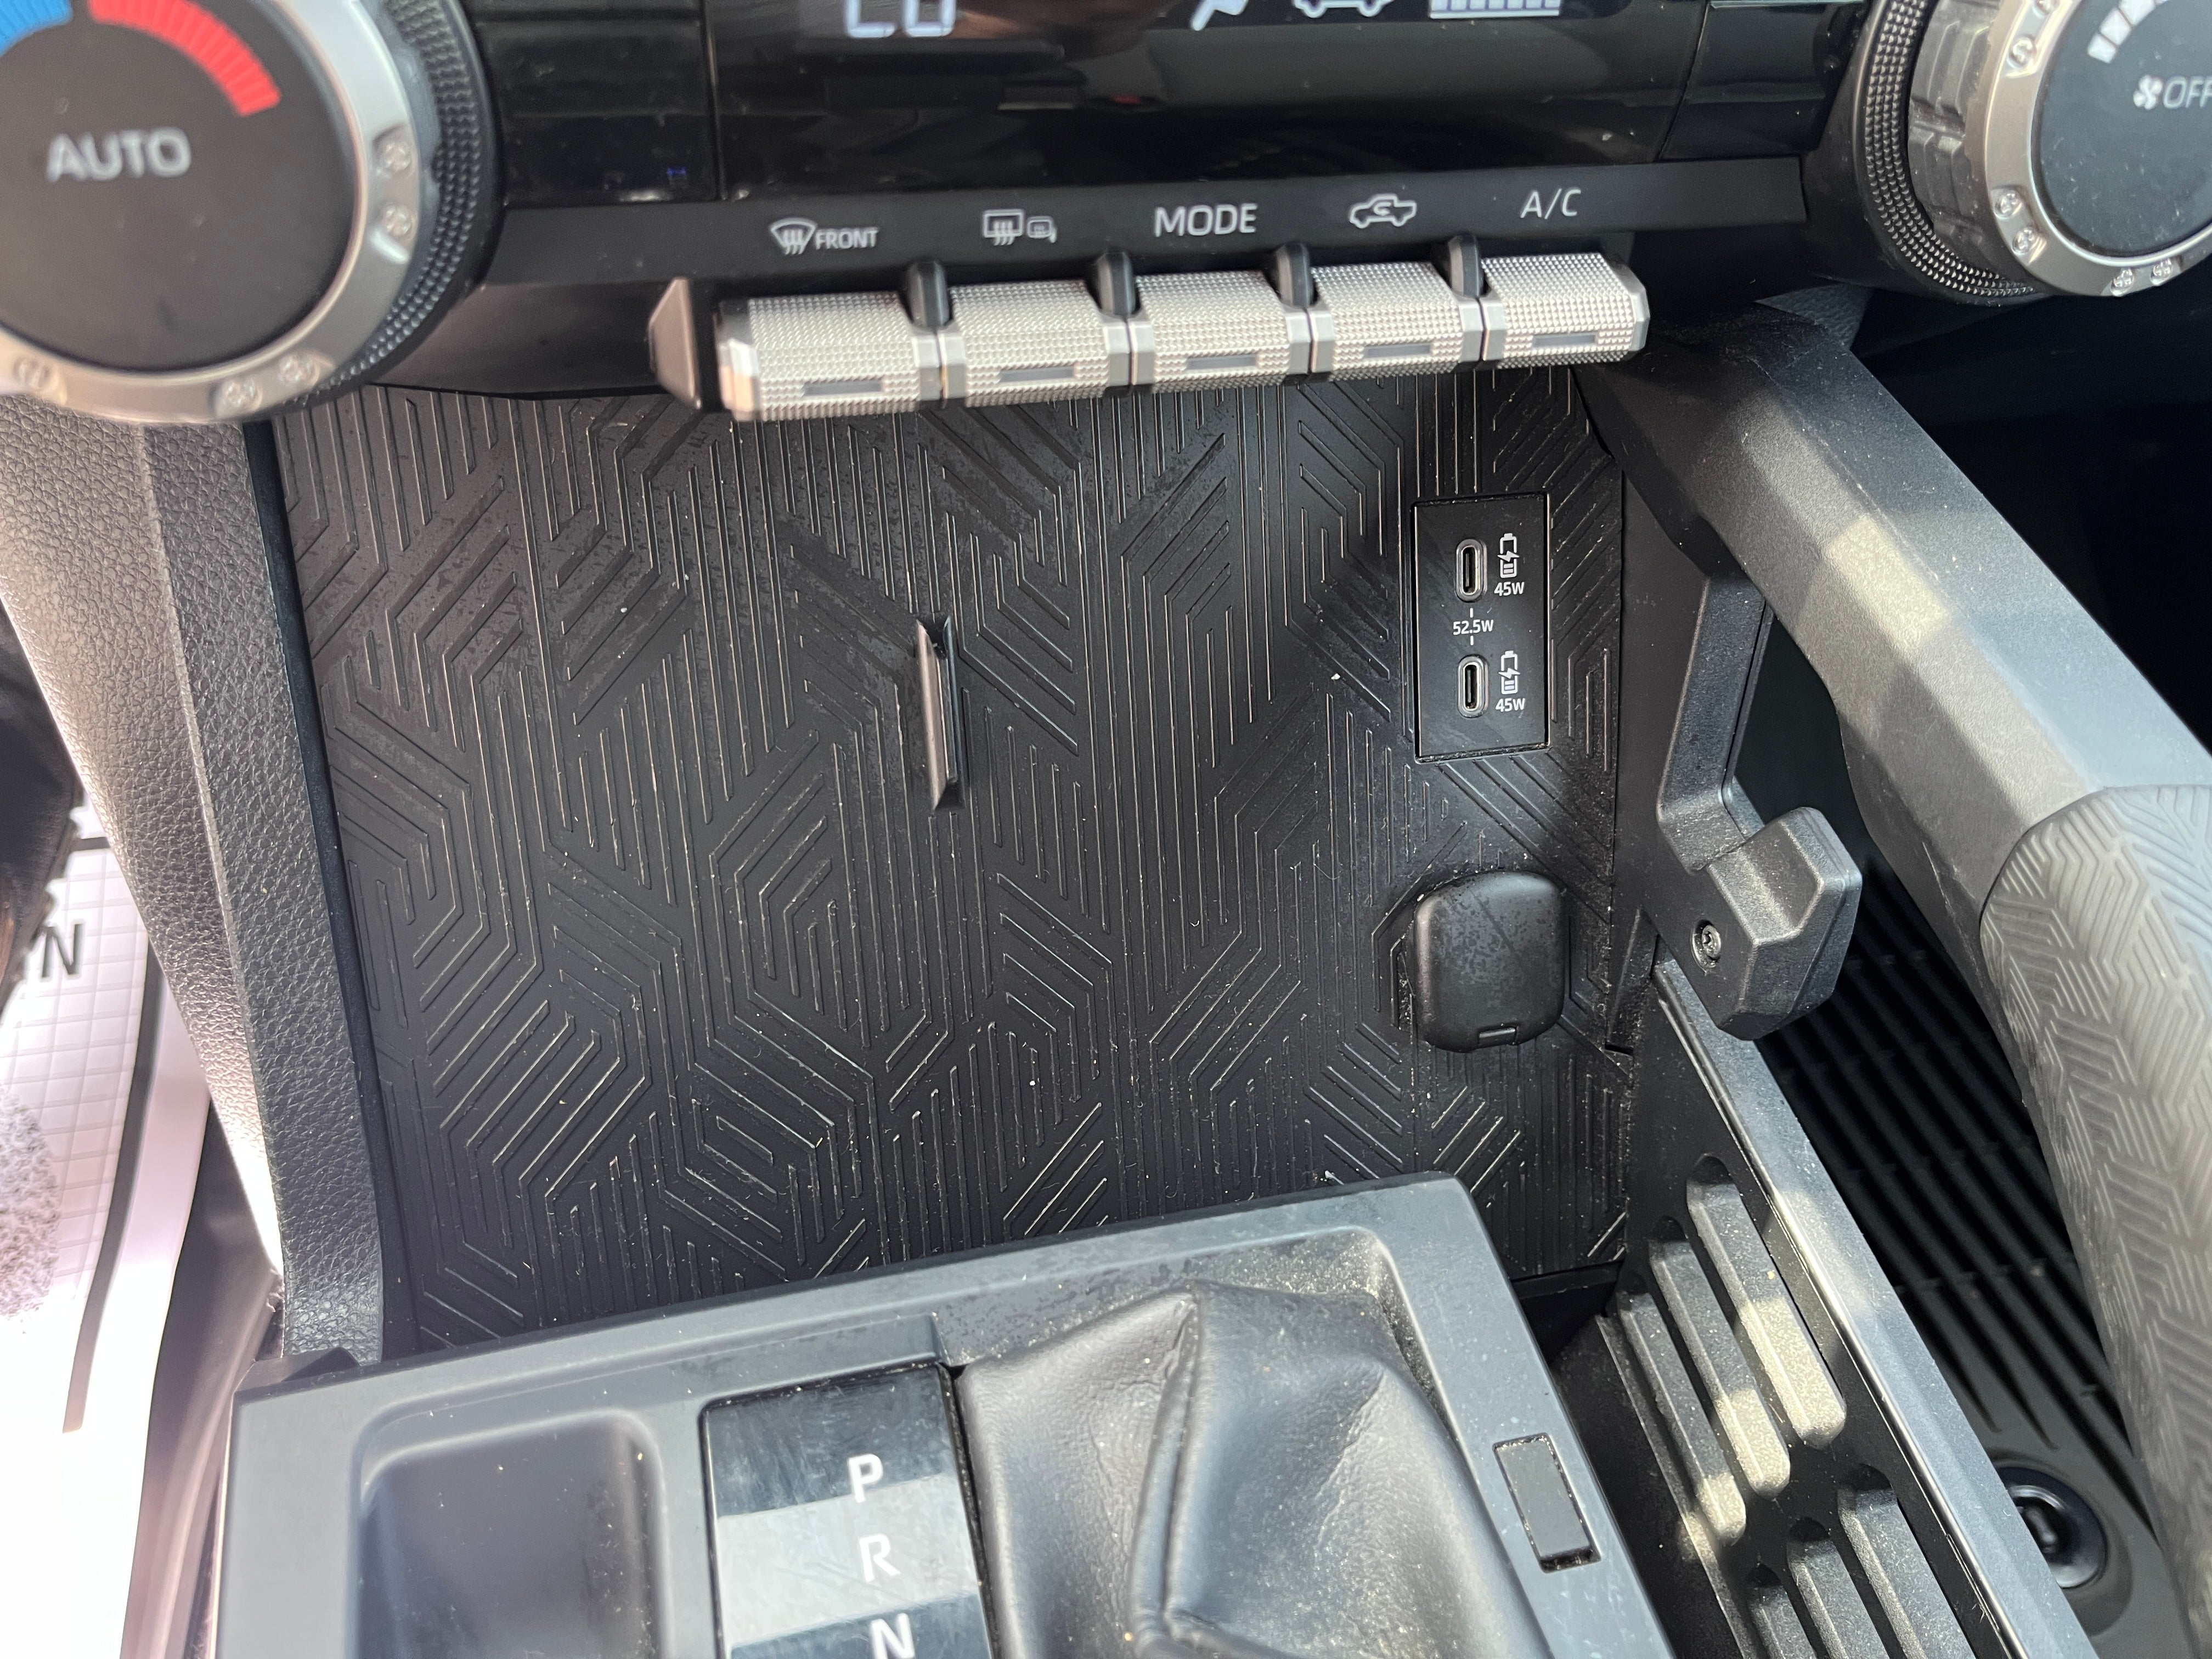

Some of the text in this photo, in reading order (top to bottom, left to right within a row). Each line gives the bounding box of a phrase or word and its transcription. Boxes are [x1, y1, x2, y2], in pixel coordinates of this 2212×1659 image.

[2163, 75, 2212, 109] OFF
[46, 127, 192, 182] AUTO
[1154, 202, 1258, 238] MODE
[1520, 188, 1582, 220] A/C
[815, 226, 879, 251] FRONT
[1493, 581, 1525, 597] 45W
[1452, 619, 1494, 636] 52.5W
[1494, 697, 1526, 713] 45W
[847, 1453, 884, 1504] P
[857, 1533, 901, 1582] R
[869, 1612, 916, 1659] N
